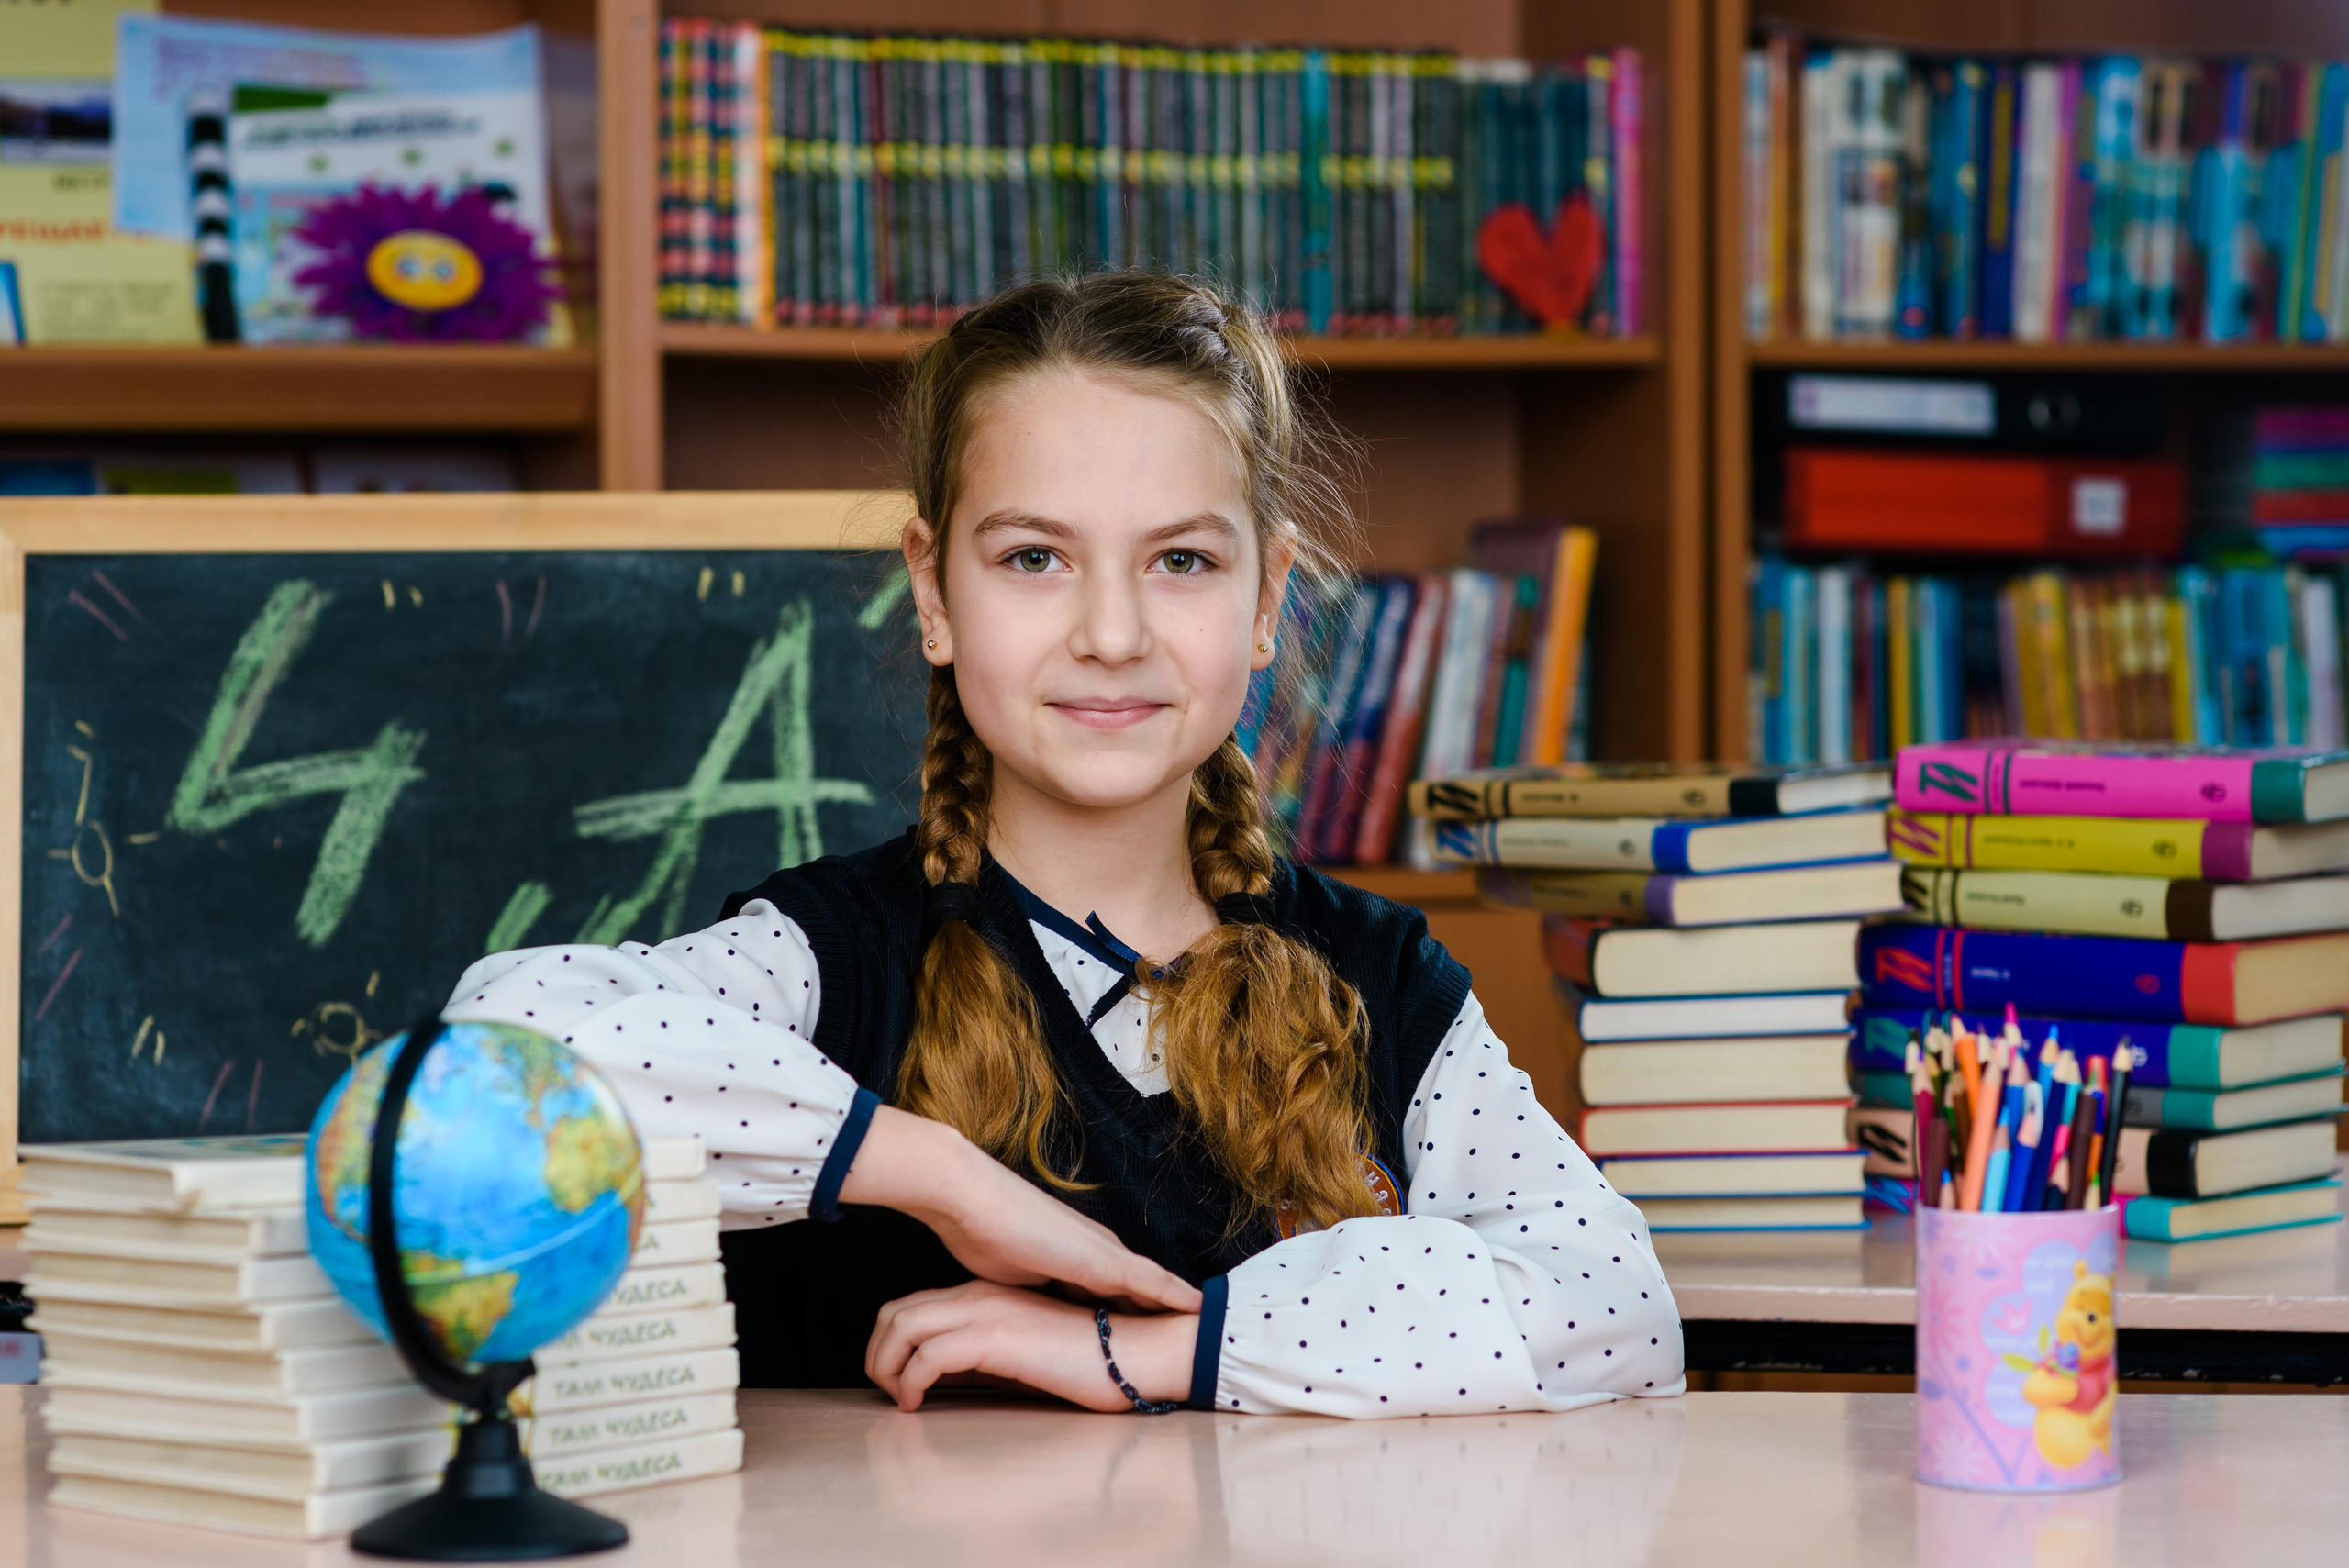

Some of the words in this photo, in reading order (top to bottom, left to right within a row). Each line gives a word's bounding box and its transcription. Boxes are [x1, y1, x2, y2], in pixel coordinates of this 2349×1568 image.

[163, 580, 426, 949] 4
[611, 1277, 686, 1307] УДЕСА
[587, 1319, 676, 1348] ЧУДЕСА
[609, 1364, 696, 1395] ЧУДЕСА
[604, 1407, 687, 1437] ЧУДЕСА
[596, 1451, 683, 1483] ЧУДЕСА
